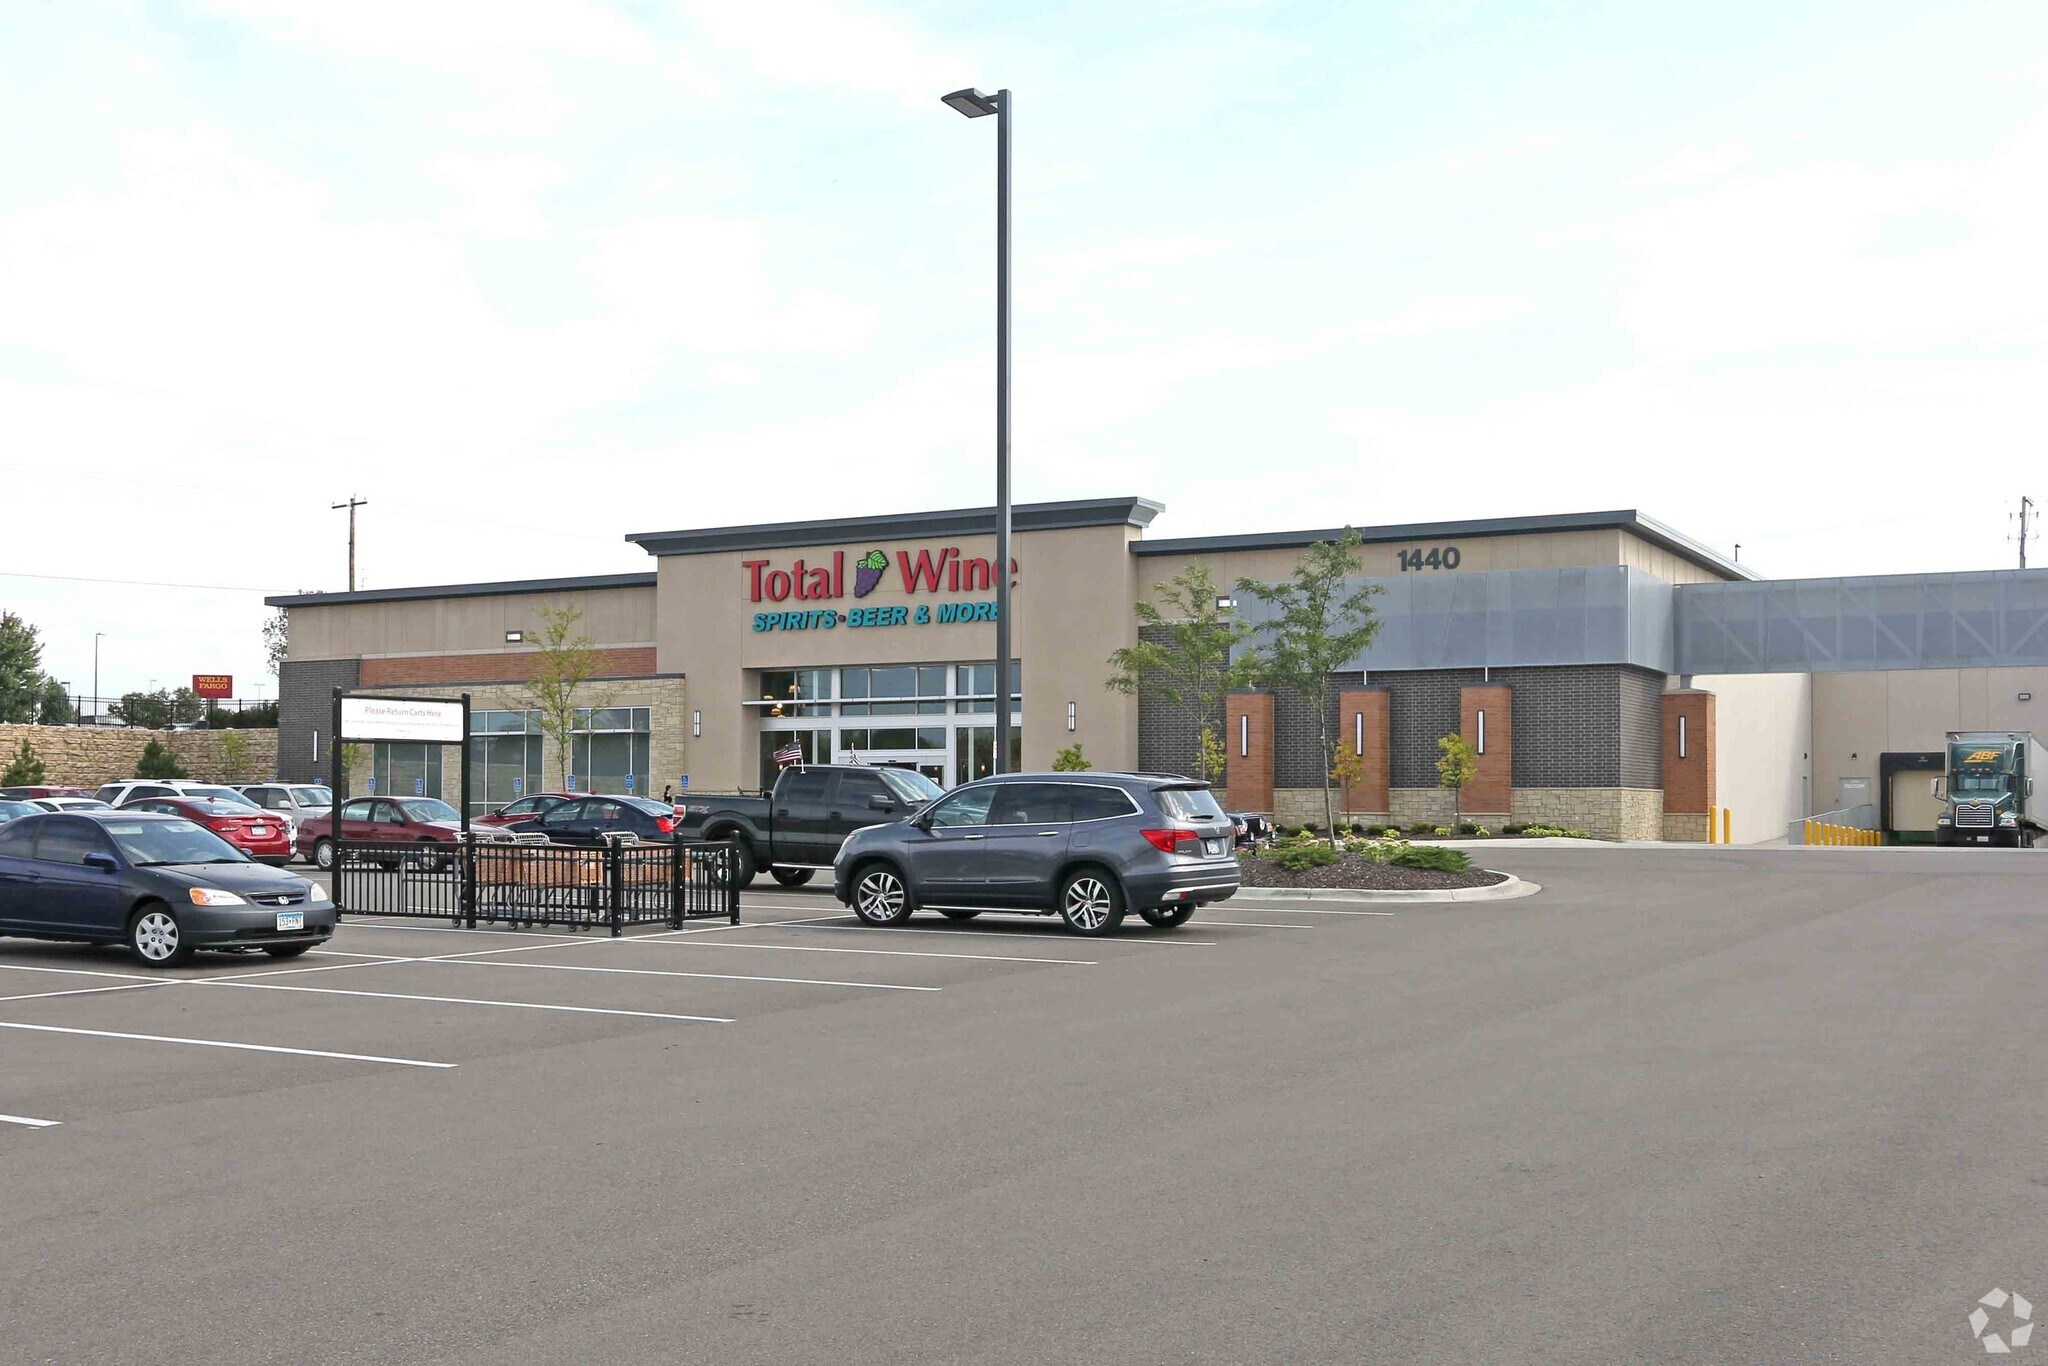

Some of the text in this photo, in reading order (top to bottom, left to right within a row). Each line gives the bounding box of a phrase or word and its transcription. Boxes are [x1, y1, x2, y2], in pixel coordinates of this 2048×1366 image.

[1397, 546, 1461, 572] 1440
[742, 550, 844, 602] Total
[753, 609, 838, 632] SPIRITS
[847, 605, 908, 627] BEER
[914, 605, 931, 624] &
[365, 706, 442, 717] Please Return Carts Here
[1967, 751, 2003, 760] ABF
